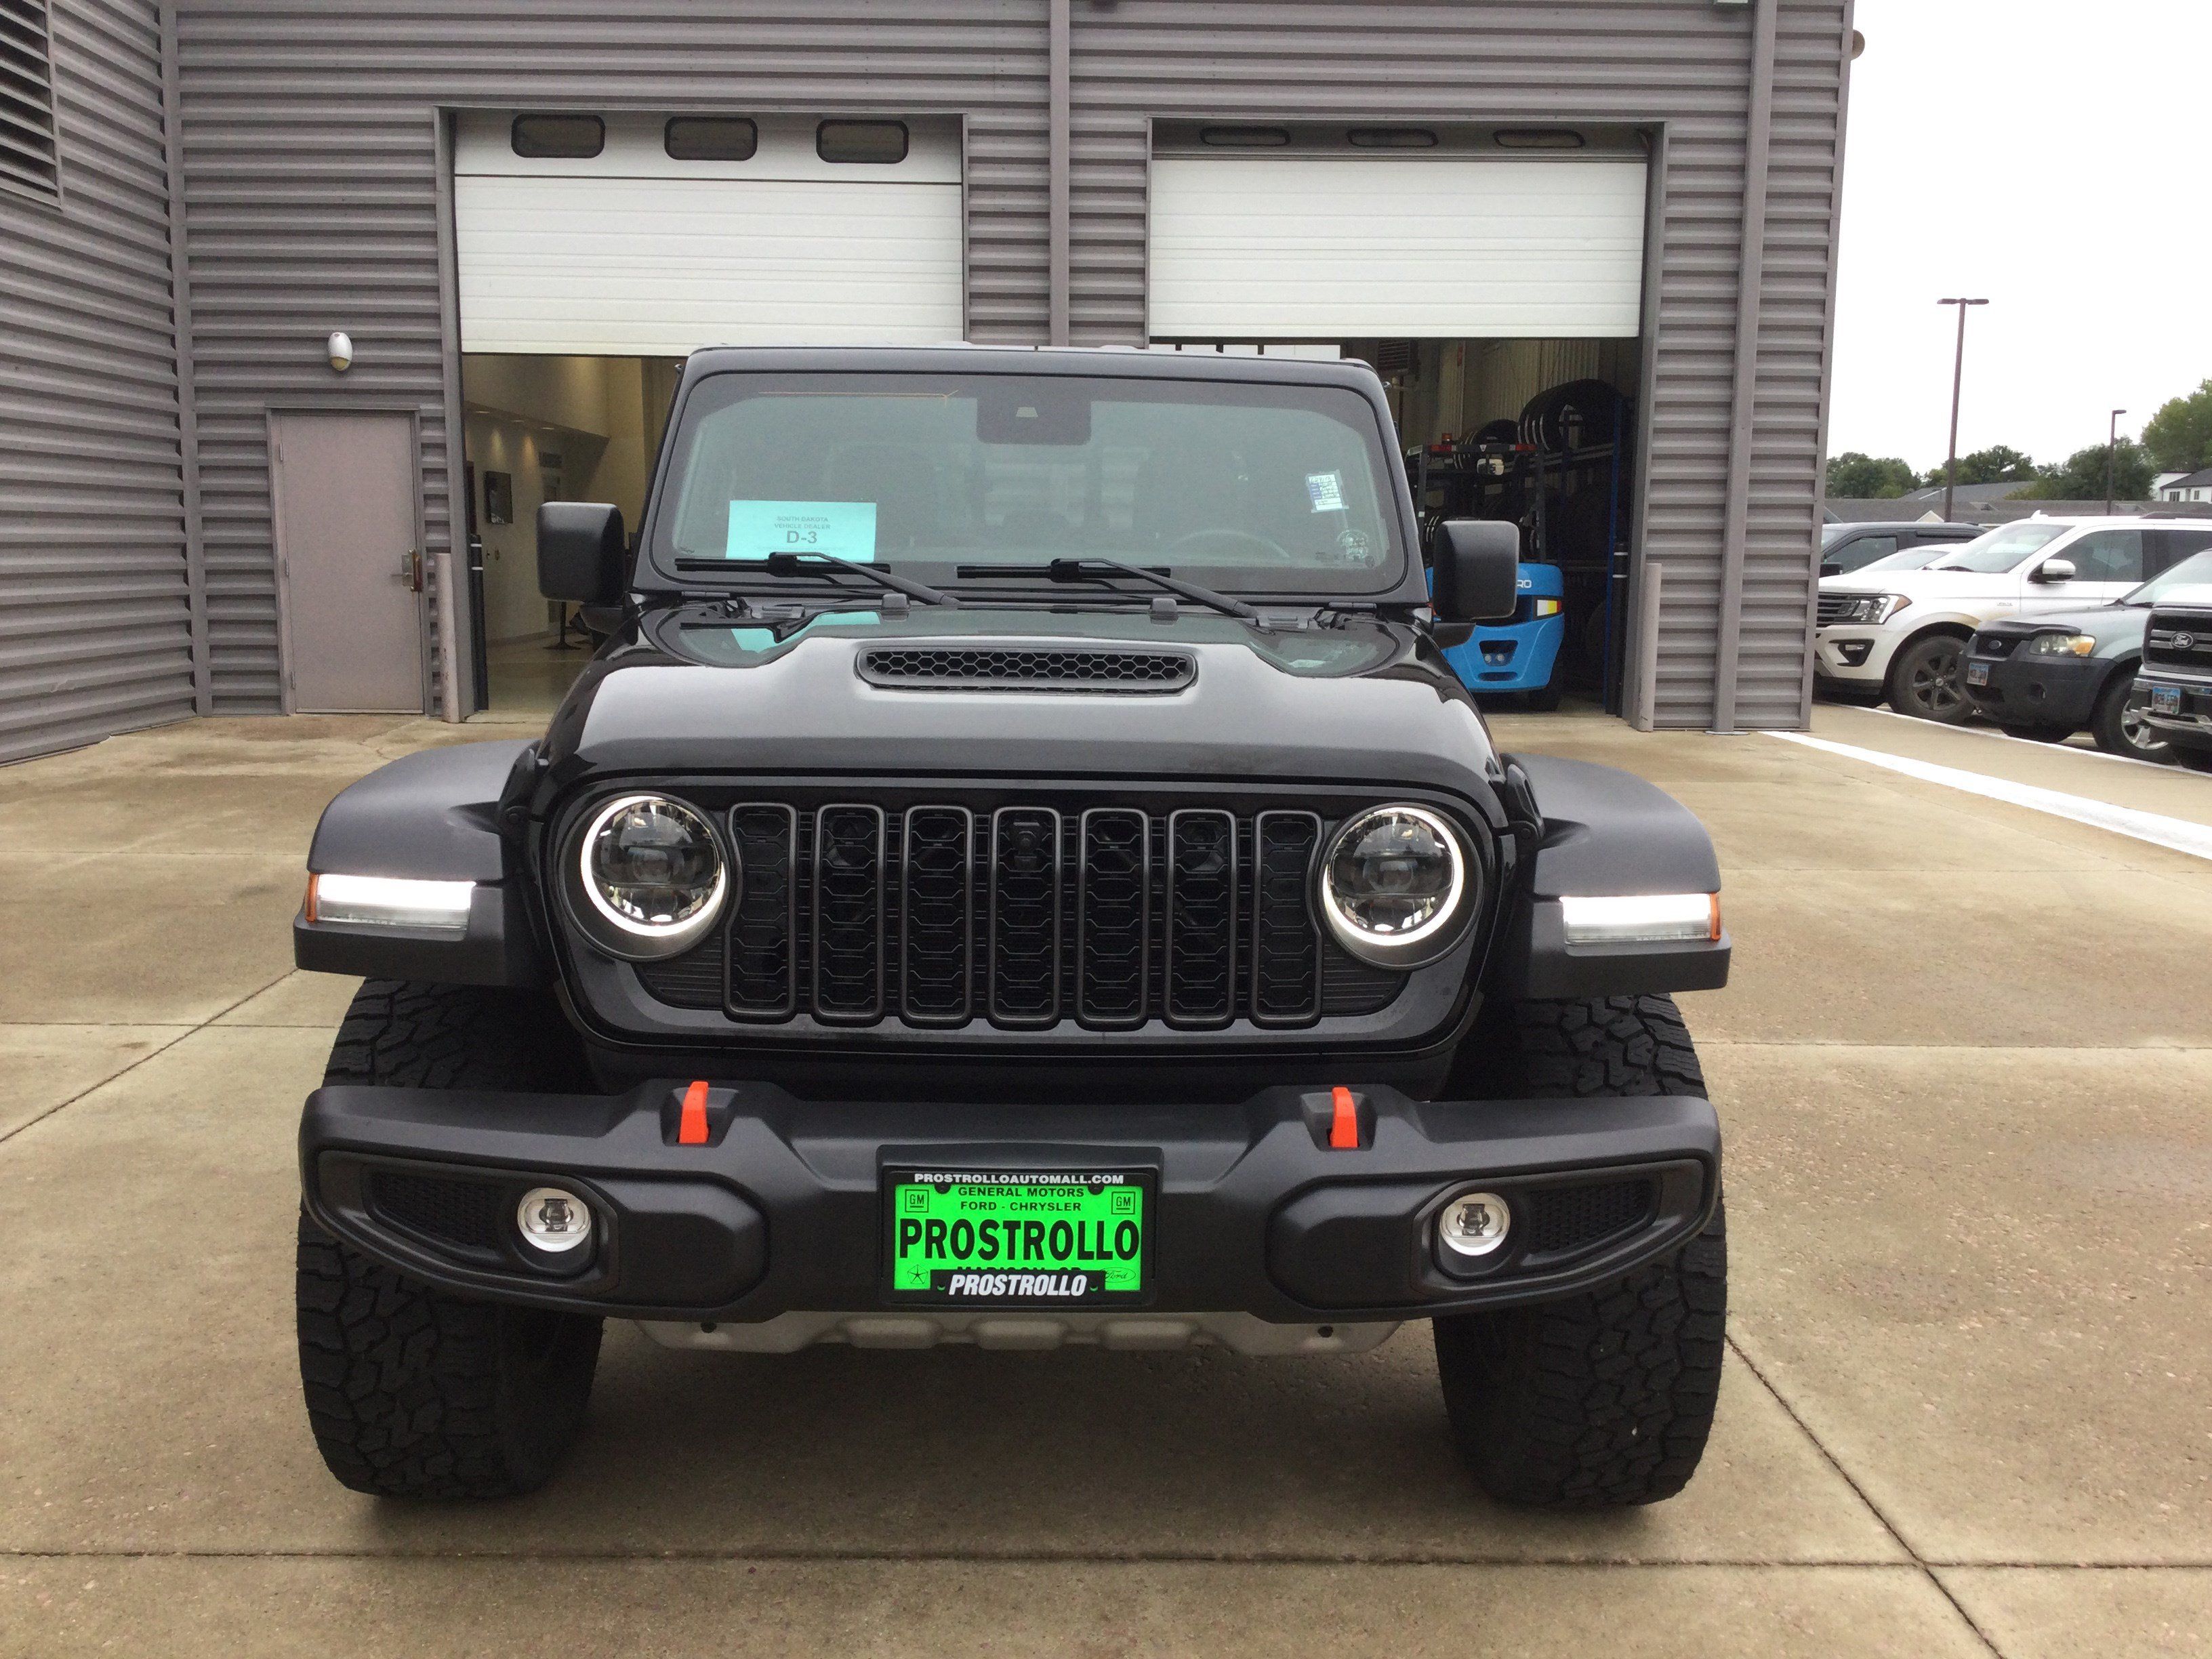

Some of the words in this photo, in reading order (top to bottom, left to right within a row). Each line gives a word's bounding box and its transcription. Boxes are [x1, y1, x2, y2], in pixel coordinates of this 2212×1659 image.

[786, 530, 817, 544] D-3
[914, 1173, 1124, 1184] PROSTROLLOAUTOMALL.COM
[958, 1187, 1023, 1197] GENERAL
[1027, 1187, 1085, 1197] MOTORS
[909, 1193, 924, 1205] GM
[1115, 1196, 1131, 1207] GM
[960, 1201, 997, 1210] FORD
[1010, 1202, 1082, 1212] CHRYSLER
[899, 1218, 1139, 1261] PROSTROLLO
[948, 1274, 1088, 1296] PROSTROLLO
